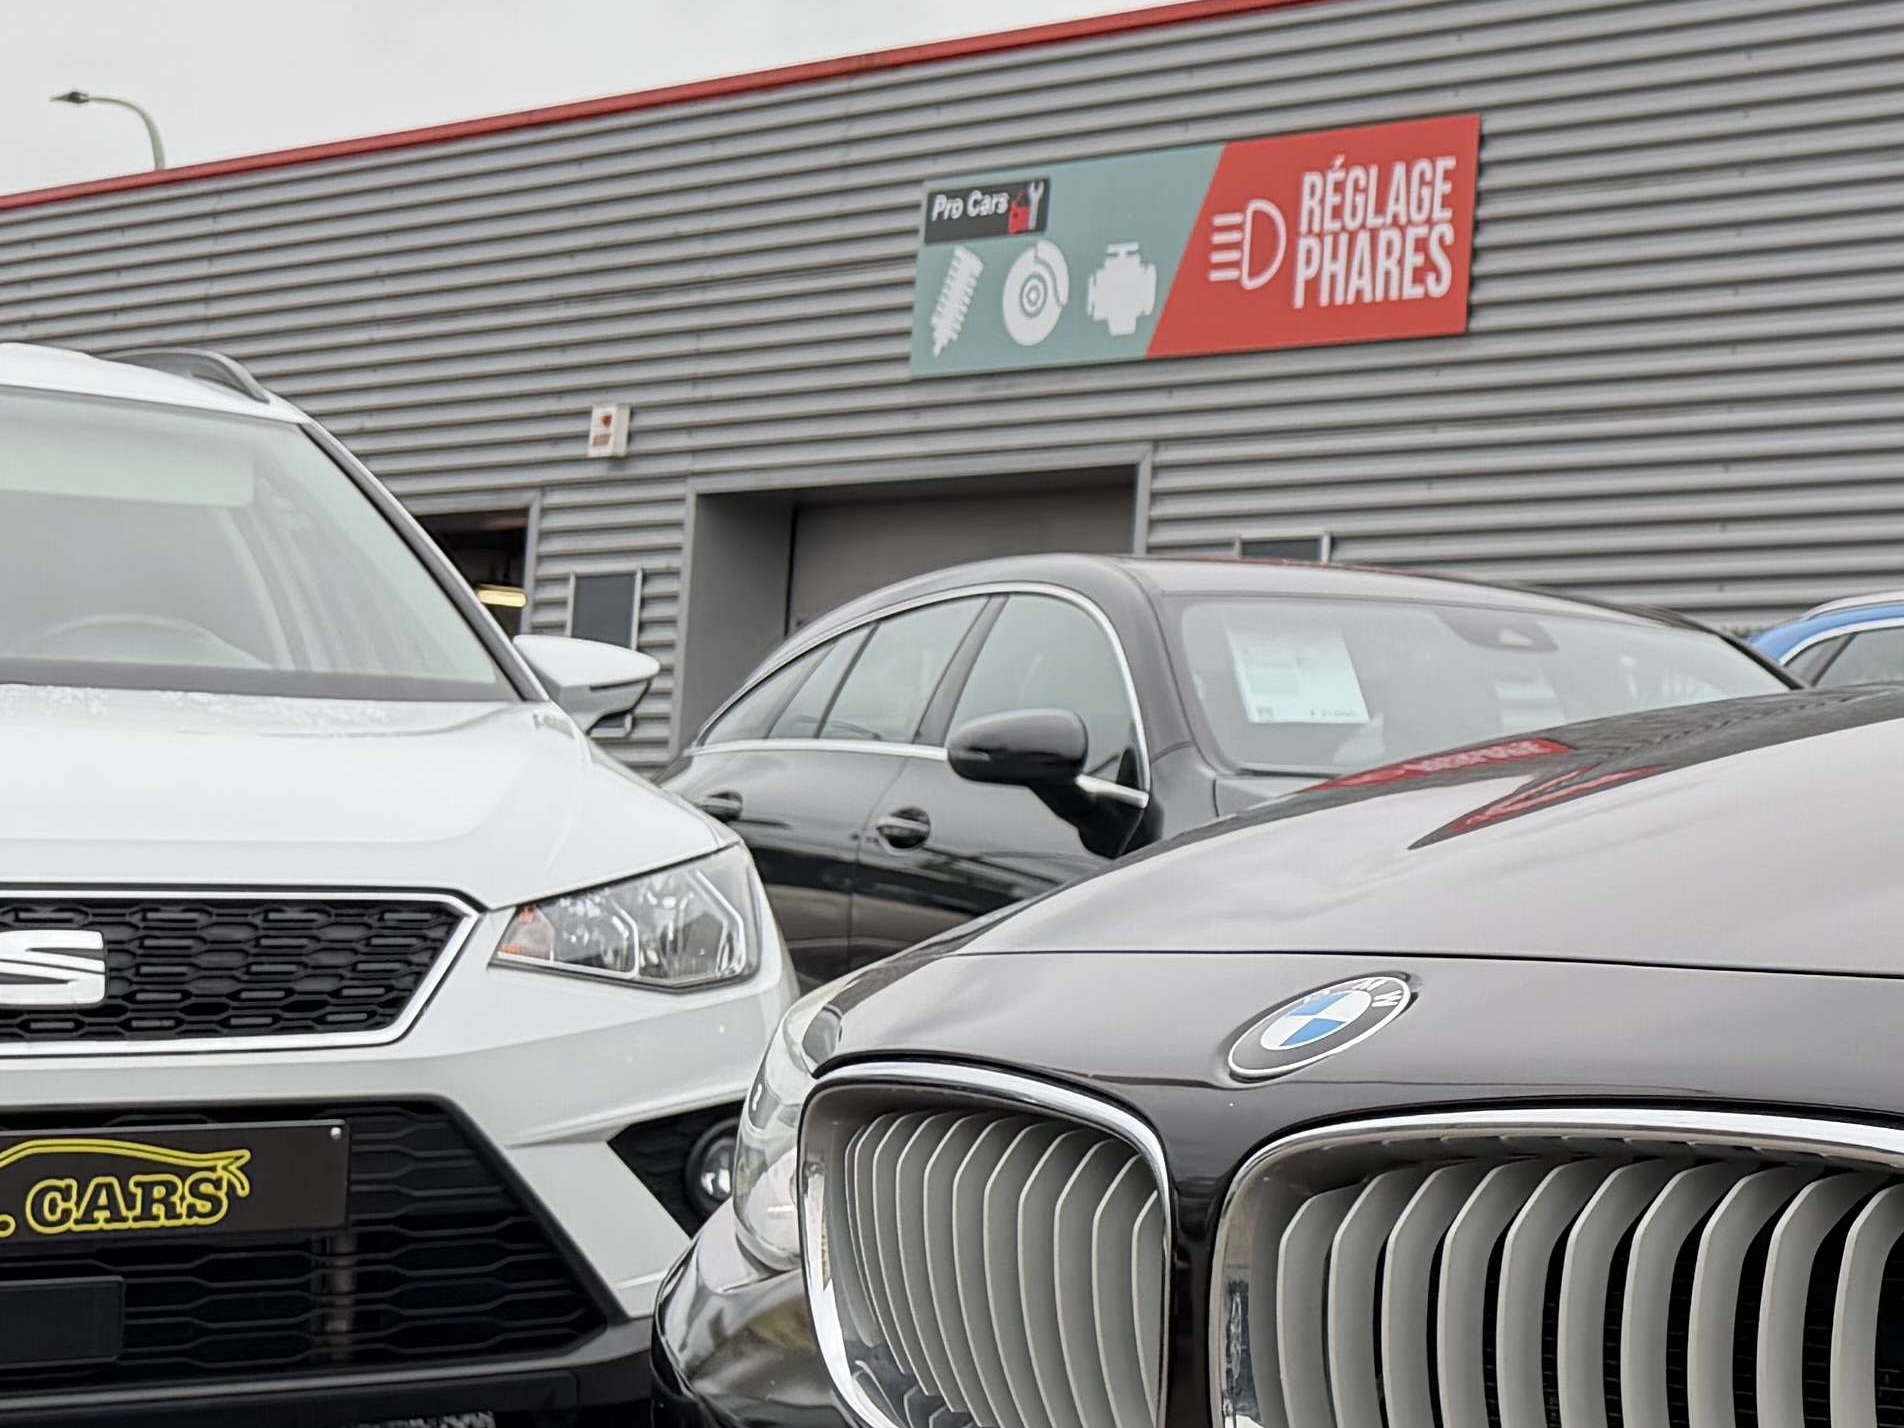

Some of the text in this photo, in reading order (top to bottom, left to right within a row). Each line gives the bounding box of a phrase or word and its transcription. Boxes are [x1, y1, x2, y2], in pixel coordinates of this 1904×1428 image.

[931, 189, 1009, 222] Pro Cars
[1300, 154, 1457, 235] RÉGLAGE
[1293, 222, 1455, 309] PHARES
[26, 1170, 229, 1235] CARS
